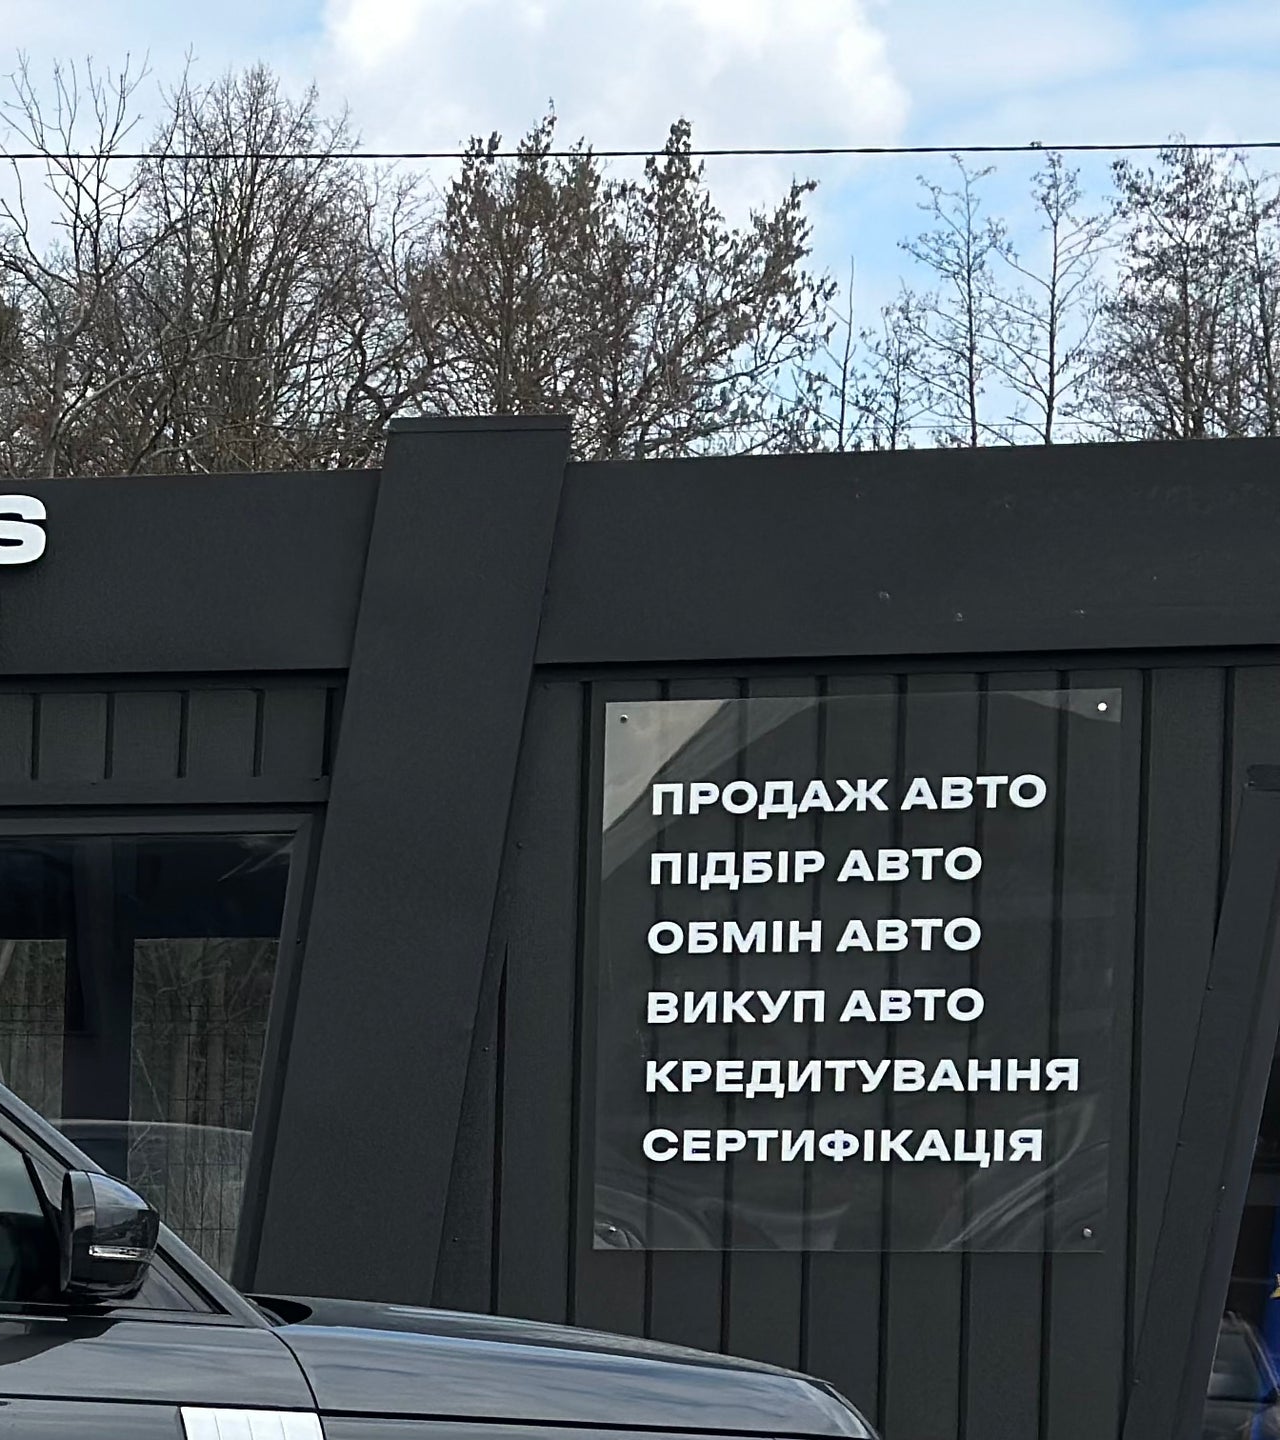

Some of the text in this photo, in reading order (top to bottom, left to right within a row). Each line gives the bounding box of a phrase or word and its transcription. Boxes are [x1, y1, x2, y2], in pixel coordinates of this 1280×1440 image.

[650, 774, 1047, 820] ПРОДАЖ АВТО
[650, 846, 982, 890] ПІДБІР АВТО
[647, 917, 982, 954] ОБМІН АВТО
[647, 987, 985, 1024] ВИКУП АВТО
[645, 1058, 1079, 1099] КРЕДИТУВАННЯ
[642, 1128, 1043, 1168] СЕРТИФІКАЦІЯ
